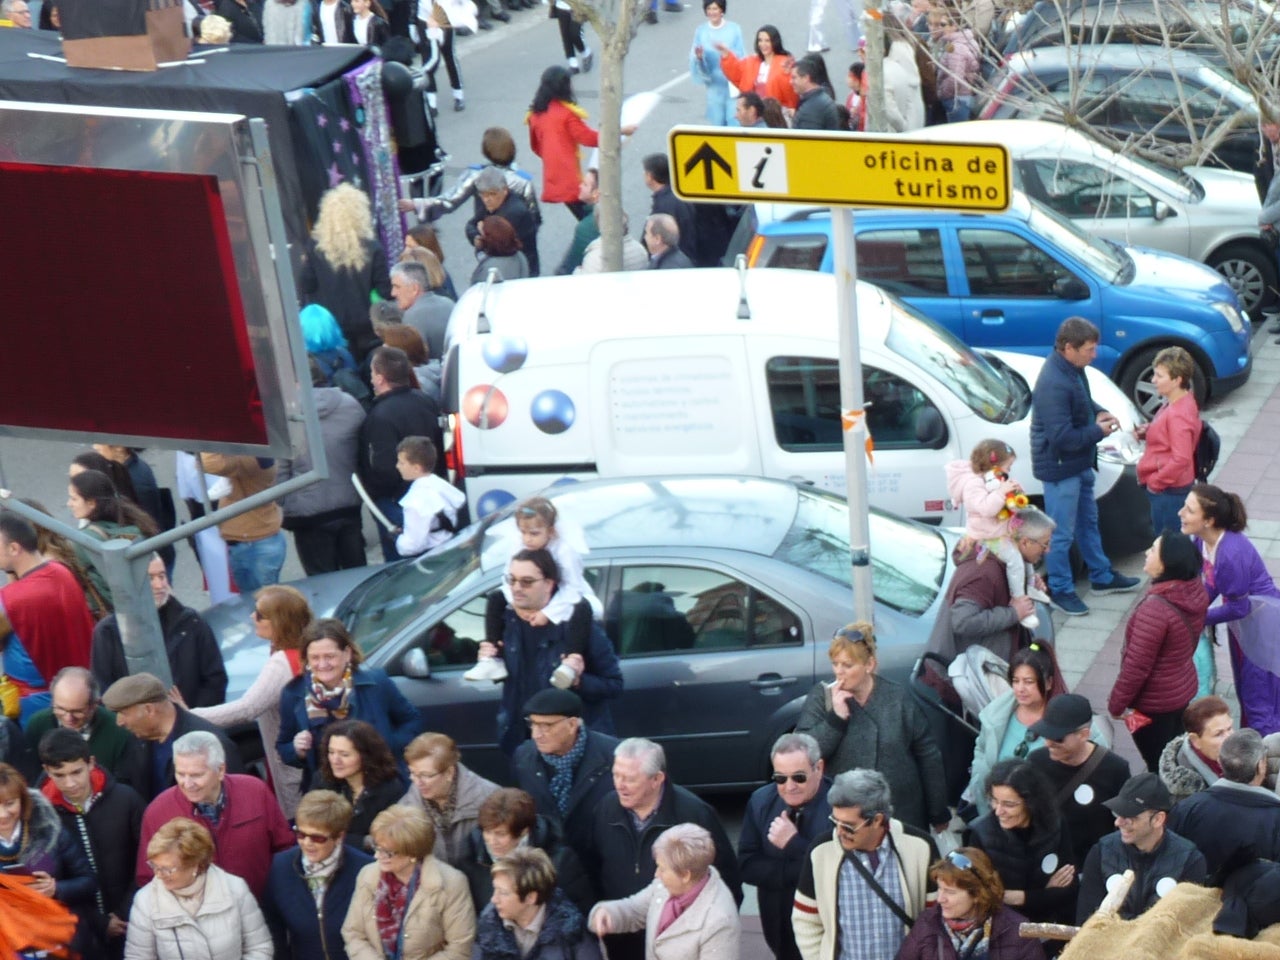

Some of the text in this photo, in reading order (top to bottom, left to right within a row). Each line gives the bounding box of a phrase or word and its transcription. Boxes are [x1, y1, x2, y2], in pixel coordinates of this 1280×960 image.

[864, 151, 998, 175] oficina de
[894, 178, 998, 200] turismo
